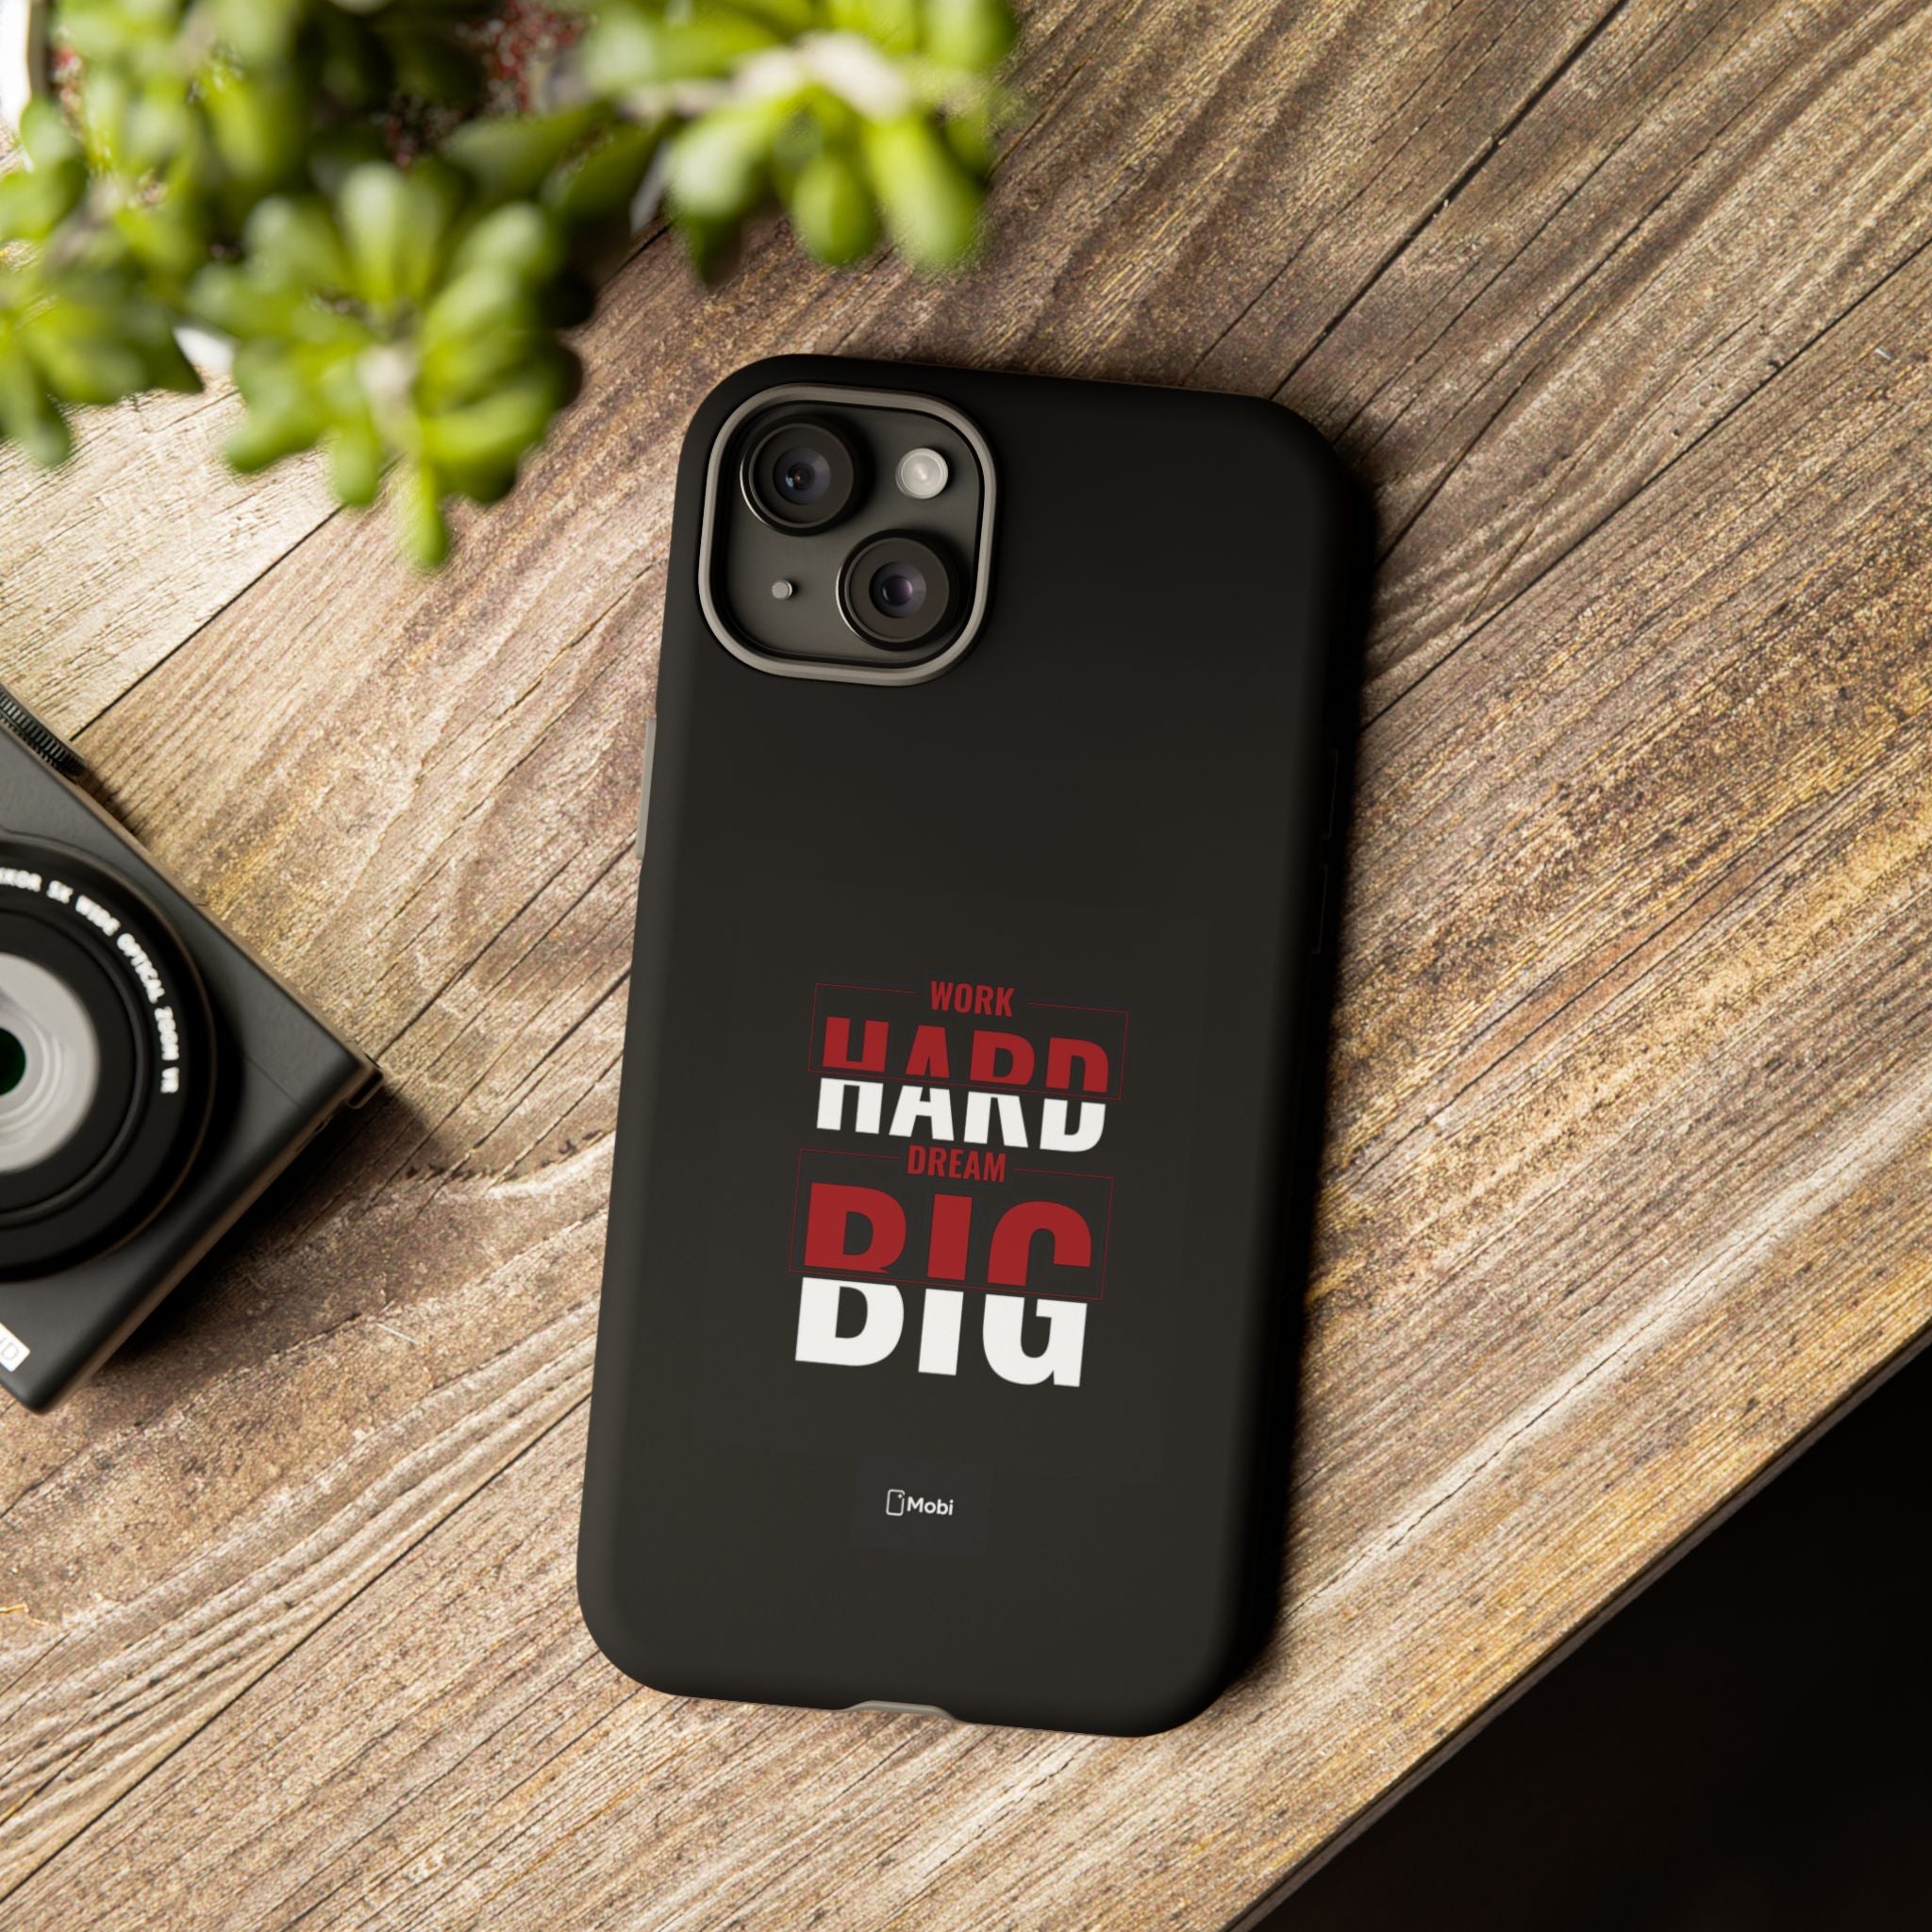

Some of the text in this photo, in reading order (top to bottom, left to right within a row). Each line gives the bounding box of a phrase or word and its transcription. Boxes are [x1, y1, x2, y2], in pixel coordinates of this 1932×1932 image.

[117, 933, 164, 1003] OPTICAL
[155, 1007, 179, 1059] ZOOM
[929, 980, 1015, 1017] WORK
[817, 1015, 1109, 1153] HARD
[907, 1144, 1007, 1183] DREAM
[795, 1181, 1092, 1387] BIG
[907, 1496, 954, 1516] Mobi
